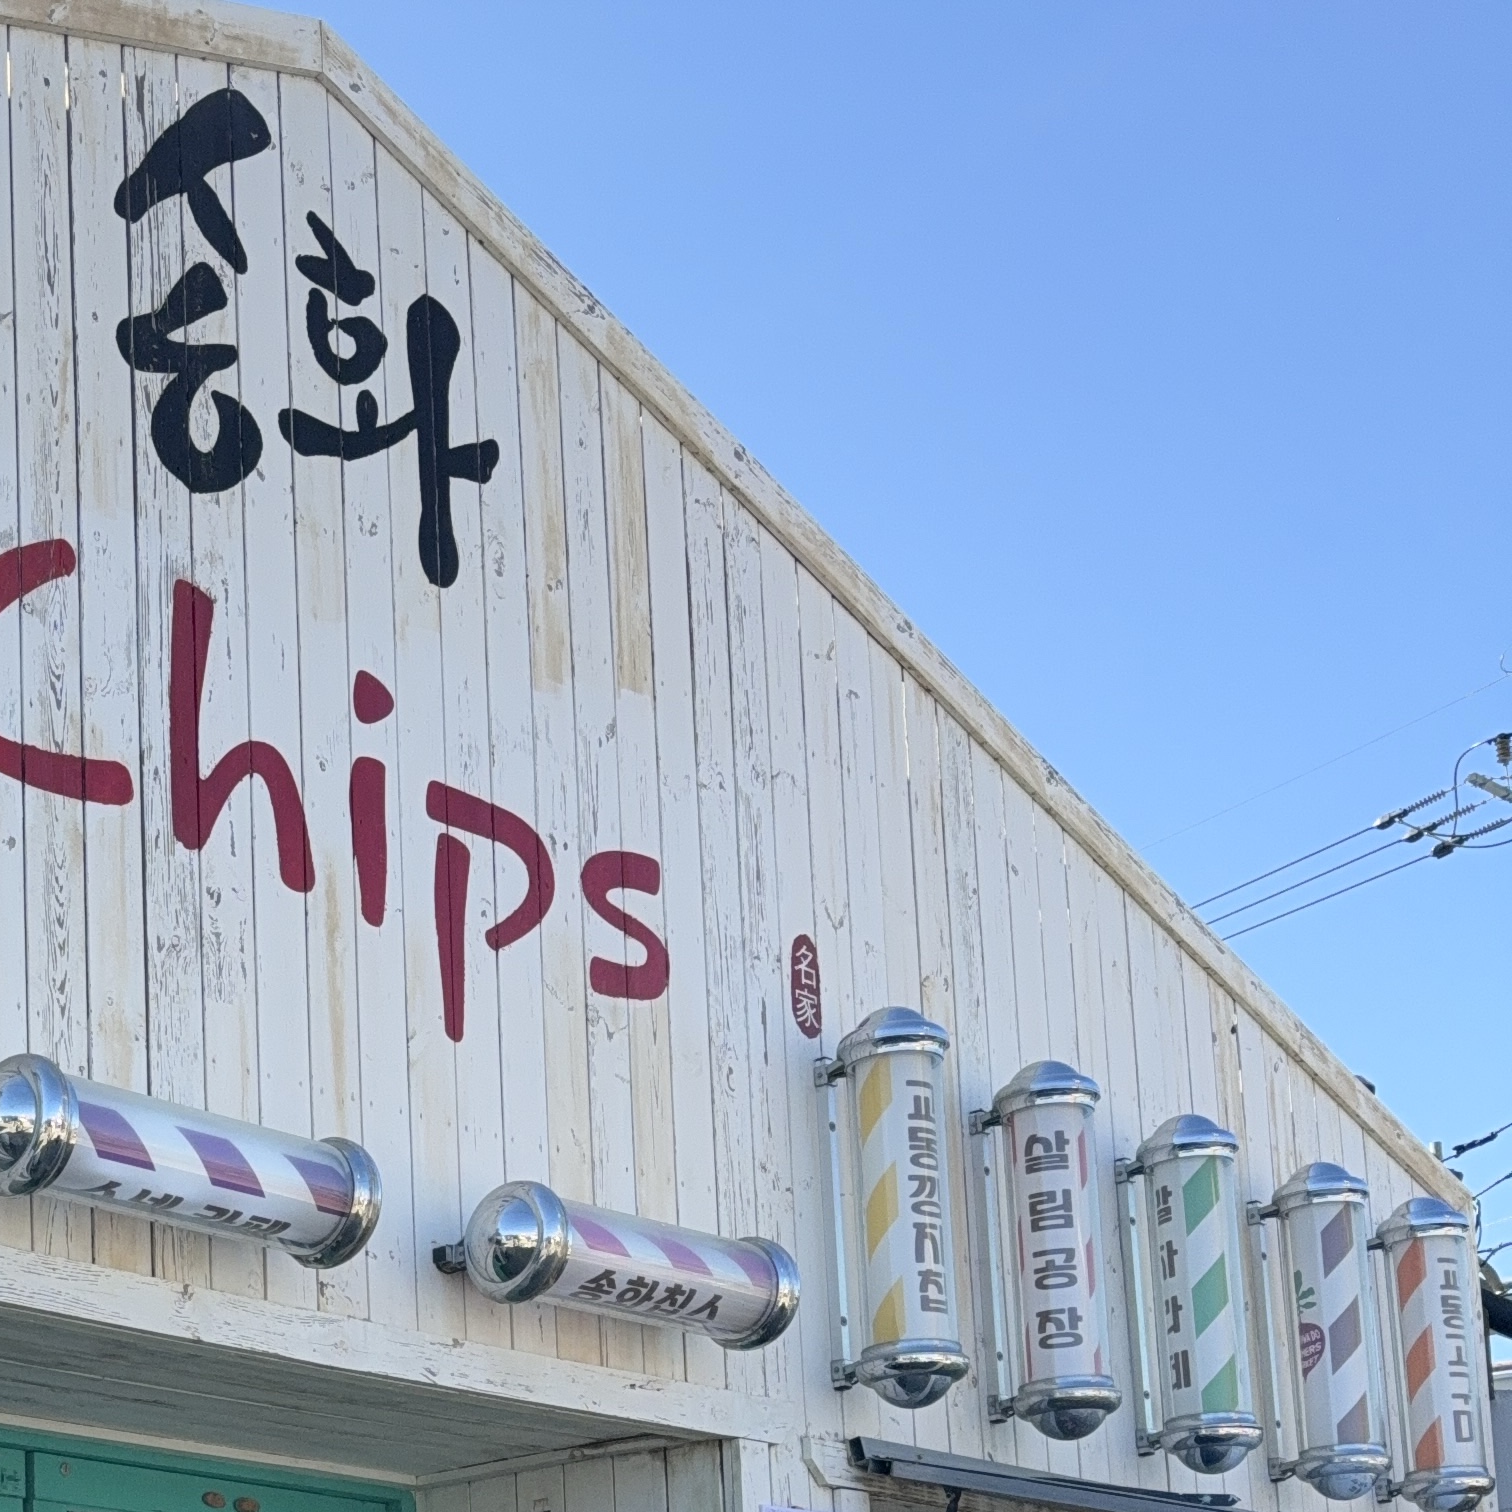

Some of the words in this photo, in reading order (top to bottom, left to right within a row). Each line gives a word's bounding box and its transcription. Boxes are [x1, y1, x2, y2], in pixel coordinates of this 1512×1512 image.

[114, 88, 499, 588] 송화
[793, 943, 819, 1031] 名家
[579, 1267, 723, 1322] 송화칩스
[905, 1080, 949, 1315] 교동깡자칩
[1023, 1130, 1084, 1350] 살림공장
